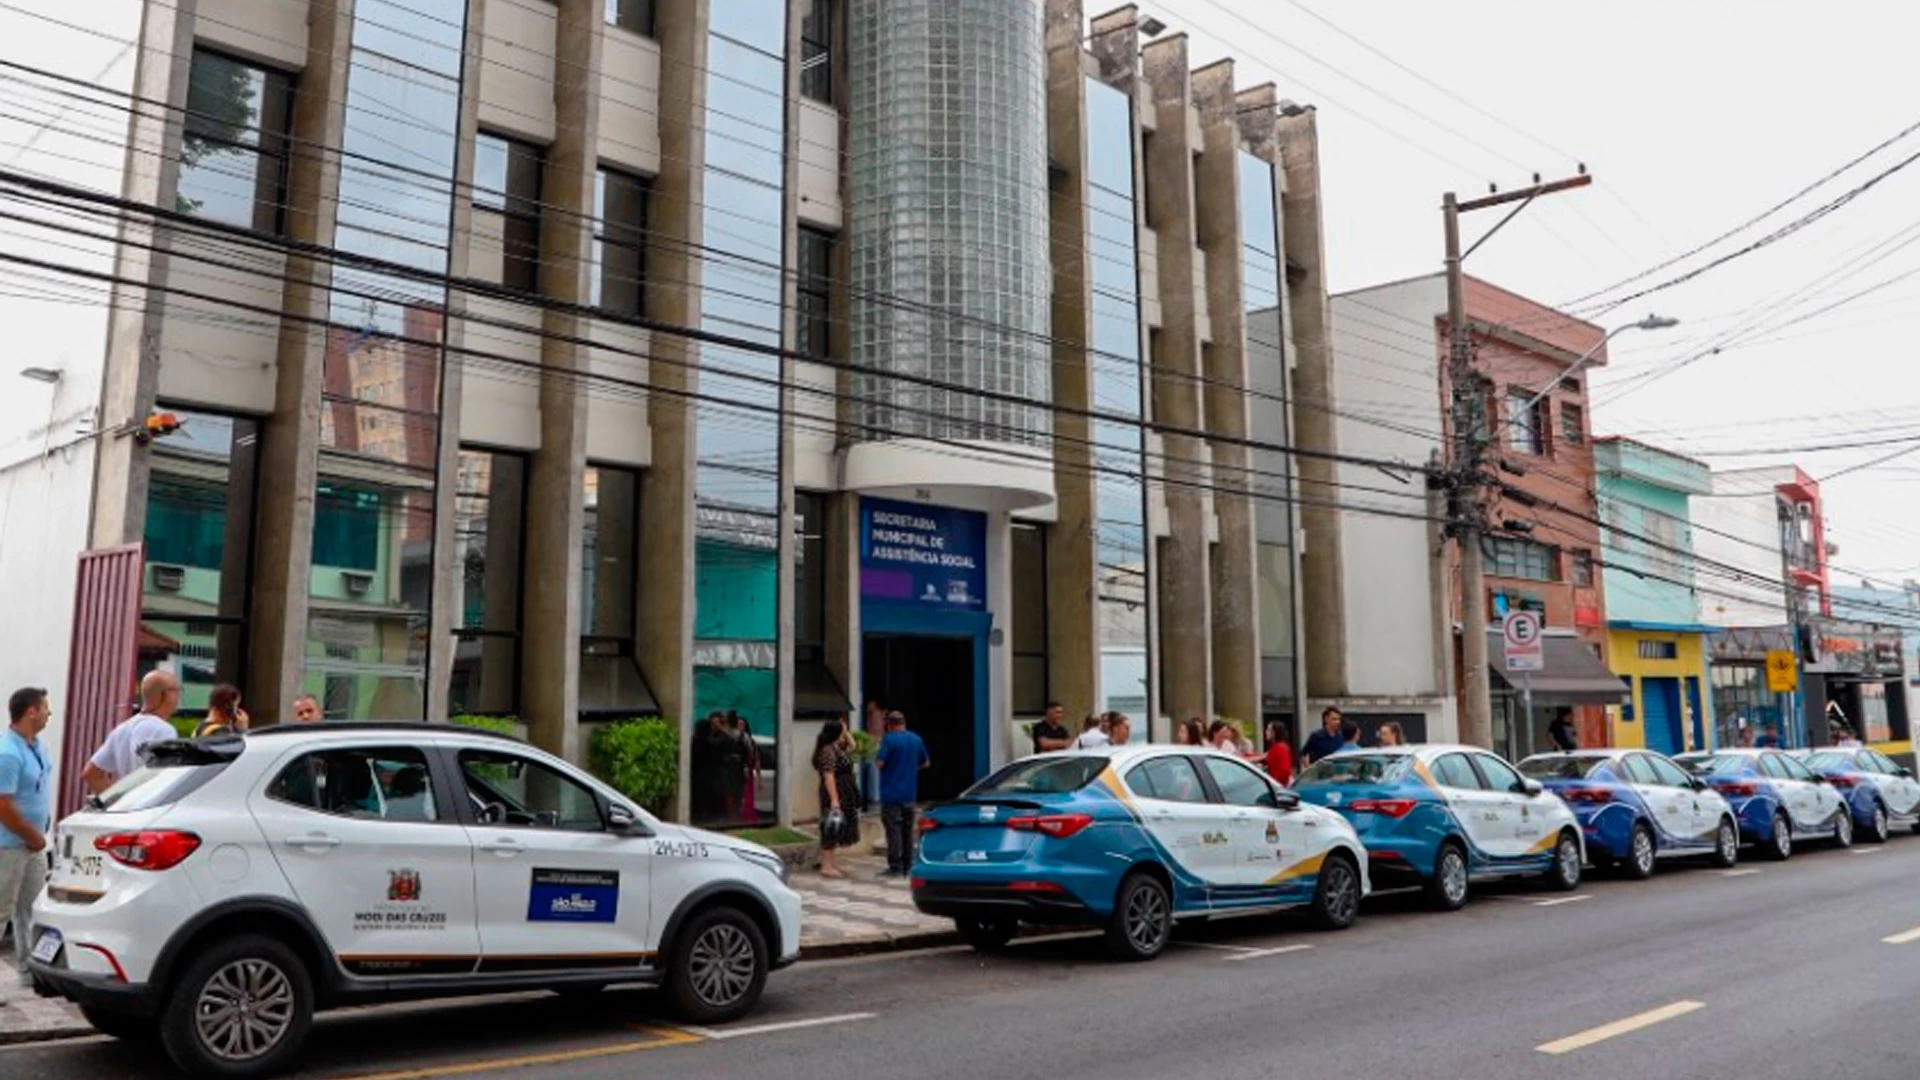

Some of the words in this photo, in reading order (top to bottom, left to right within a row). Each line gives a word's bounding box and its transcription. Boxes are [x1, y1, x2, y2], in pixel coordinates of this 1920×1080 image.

[873, 511, 936, 530] SECRETARIA
[872, 529, 929, 547] MUNICIPAL
[930, 536, 944, 549] DE
[872, 547, 938, 564] ASSISTÊNCIA
[940, 553, 976, 569] SOCIAL
[1515, 620, 1528, 639] E
[386, 912, 407, 922] DAS
[409, 912, 447, 923] CRUZES
